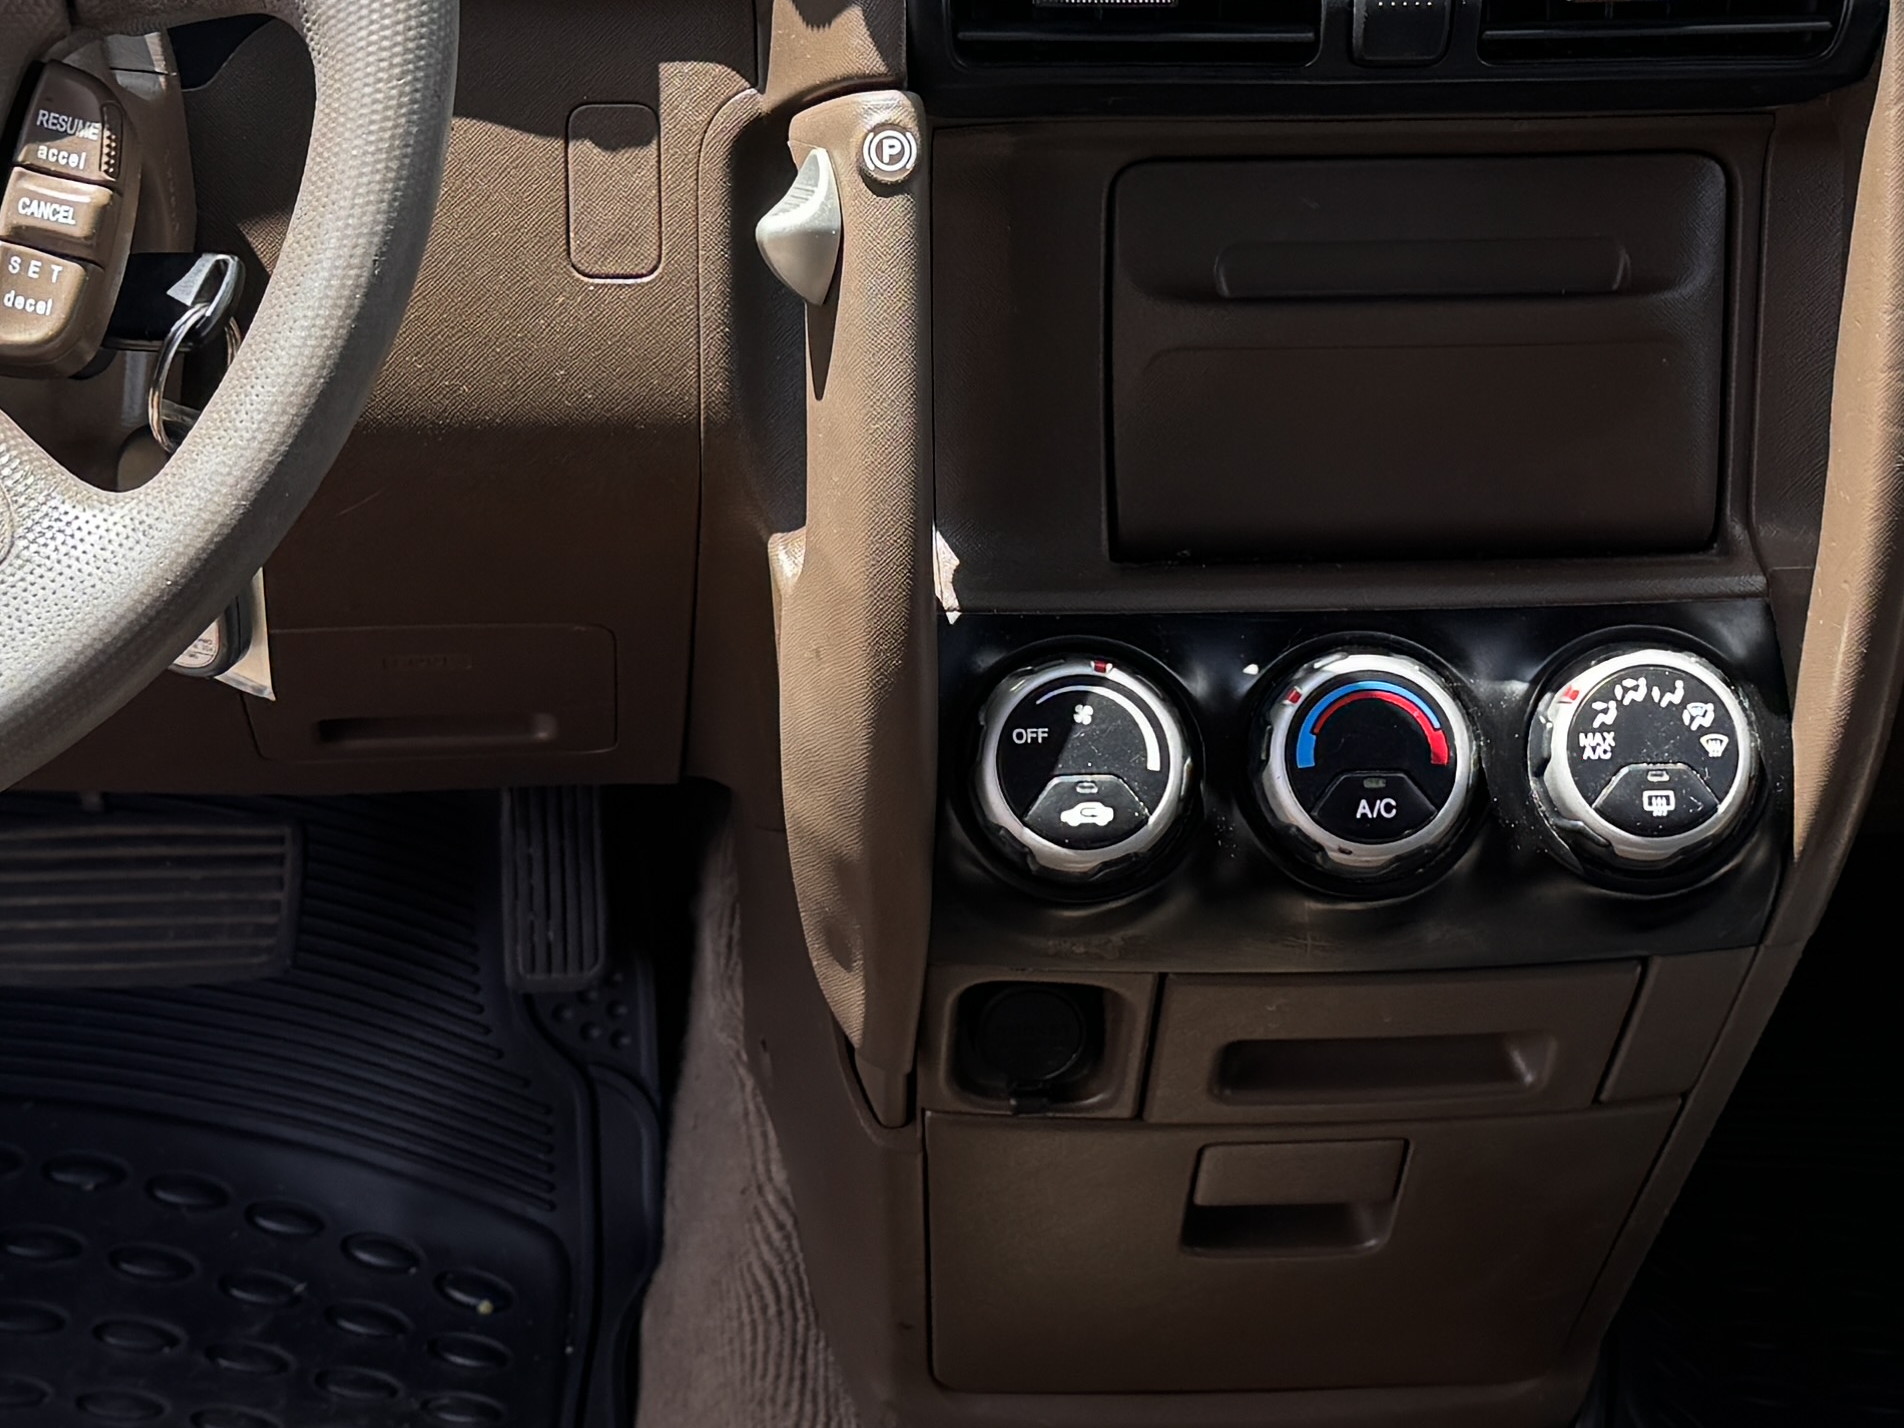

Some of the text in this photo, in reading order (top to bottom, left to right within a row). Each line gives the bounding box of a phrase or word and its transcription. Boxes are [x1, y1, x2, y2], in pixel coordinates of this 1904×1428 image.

[36, 109, 103, 140] RESUME
[37, 145, 86, 170] accel
[18, 197, 76, 225] CANCEL
[3, 290, 53, 315] decel
[1012, 728, 1049, 744] OFF
[1579, 731, 1616, 747] MAX
[1582, 745, 1612, 760] A/C
[1356, 798, 1397, 818] A/C
